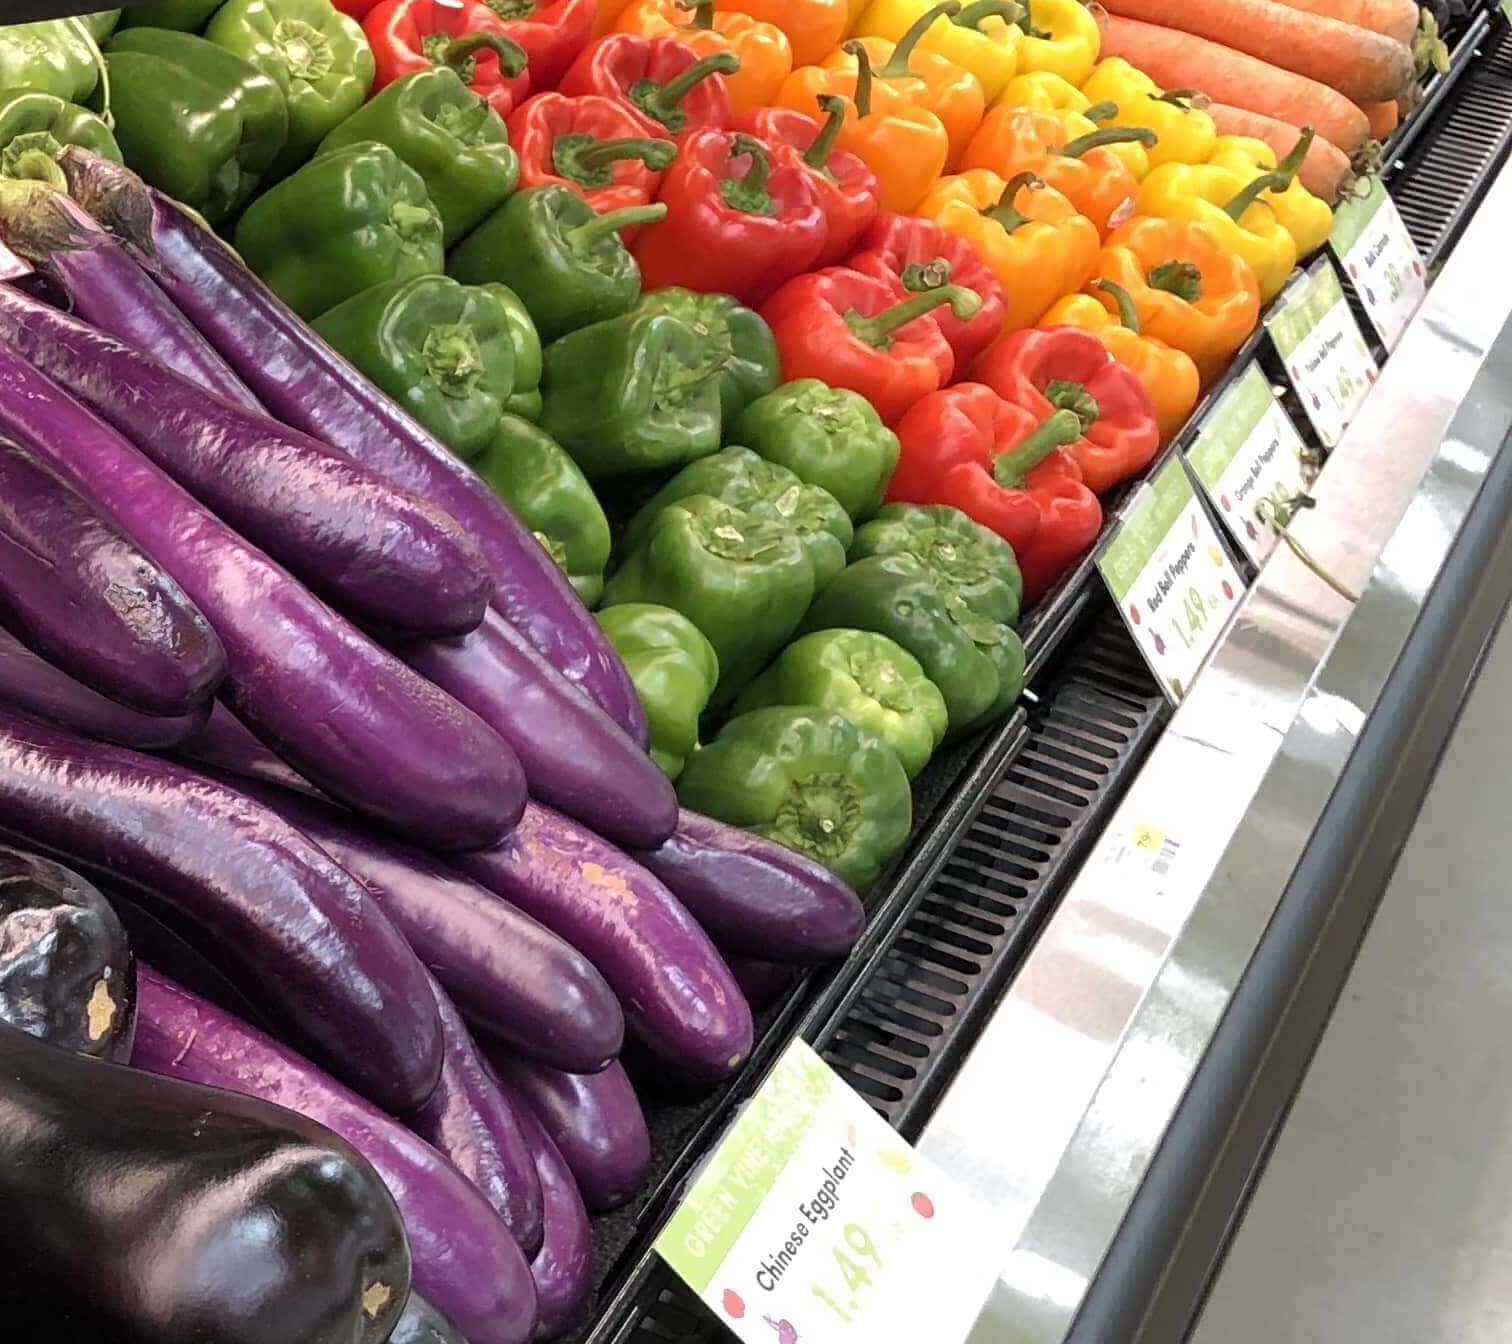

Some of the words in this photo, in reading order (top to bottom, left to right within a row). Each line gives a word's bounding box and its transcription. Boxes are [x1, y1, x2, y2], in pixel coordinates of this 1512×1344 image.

[1146, 594, 1163, 613] Red
[1158, 573, 1175, 596] Bell
[1168, 542, 1196, 579] Peppers
[685, 1188, 738, 1258] GREEN
[756, 1219, 810, 1292] Chinese
[799, 1146, 856, 1224] Eggplant
